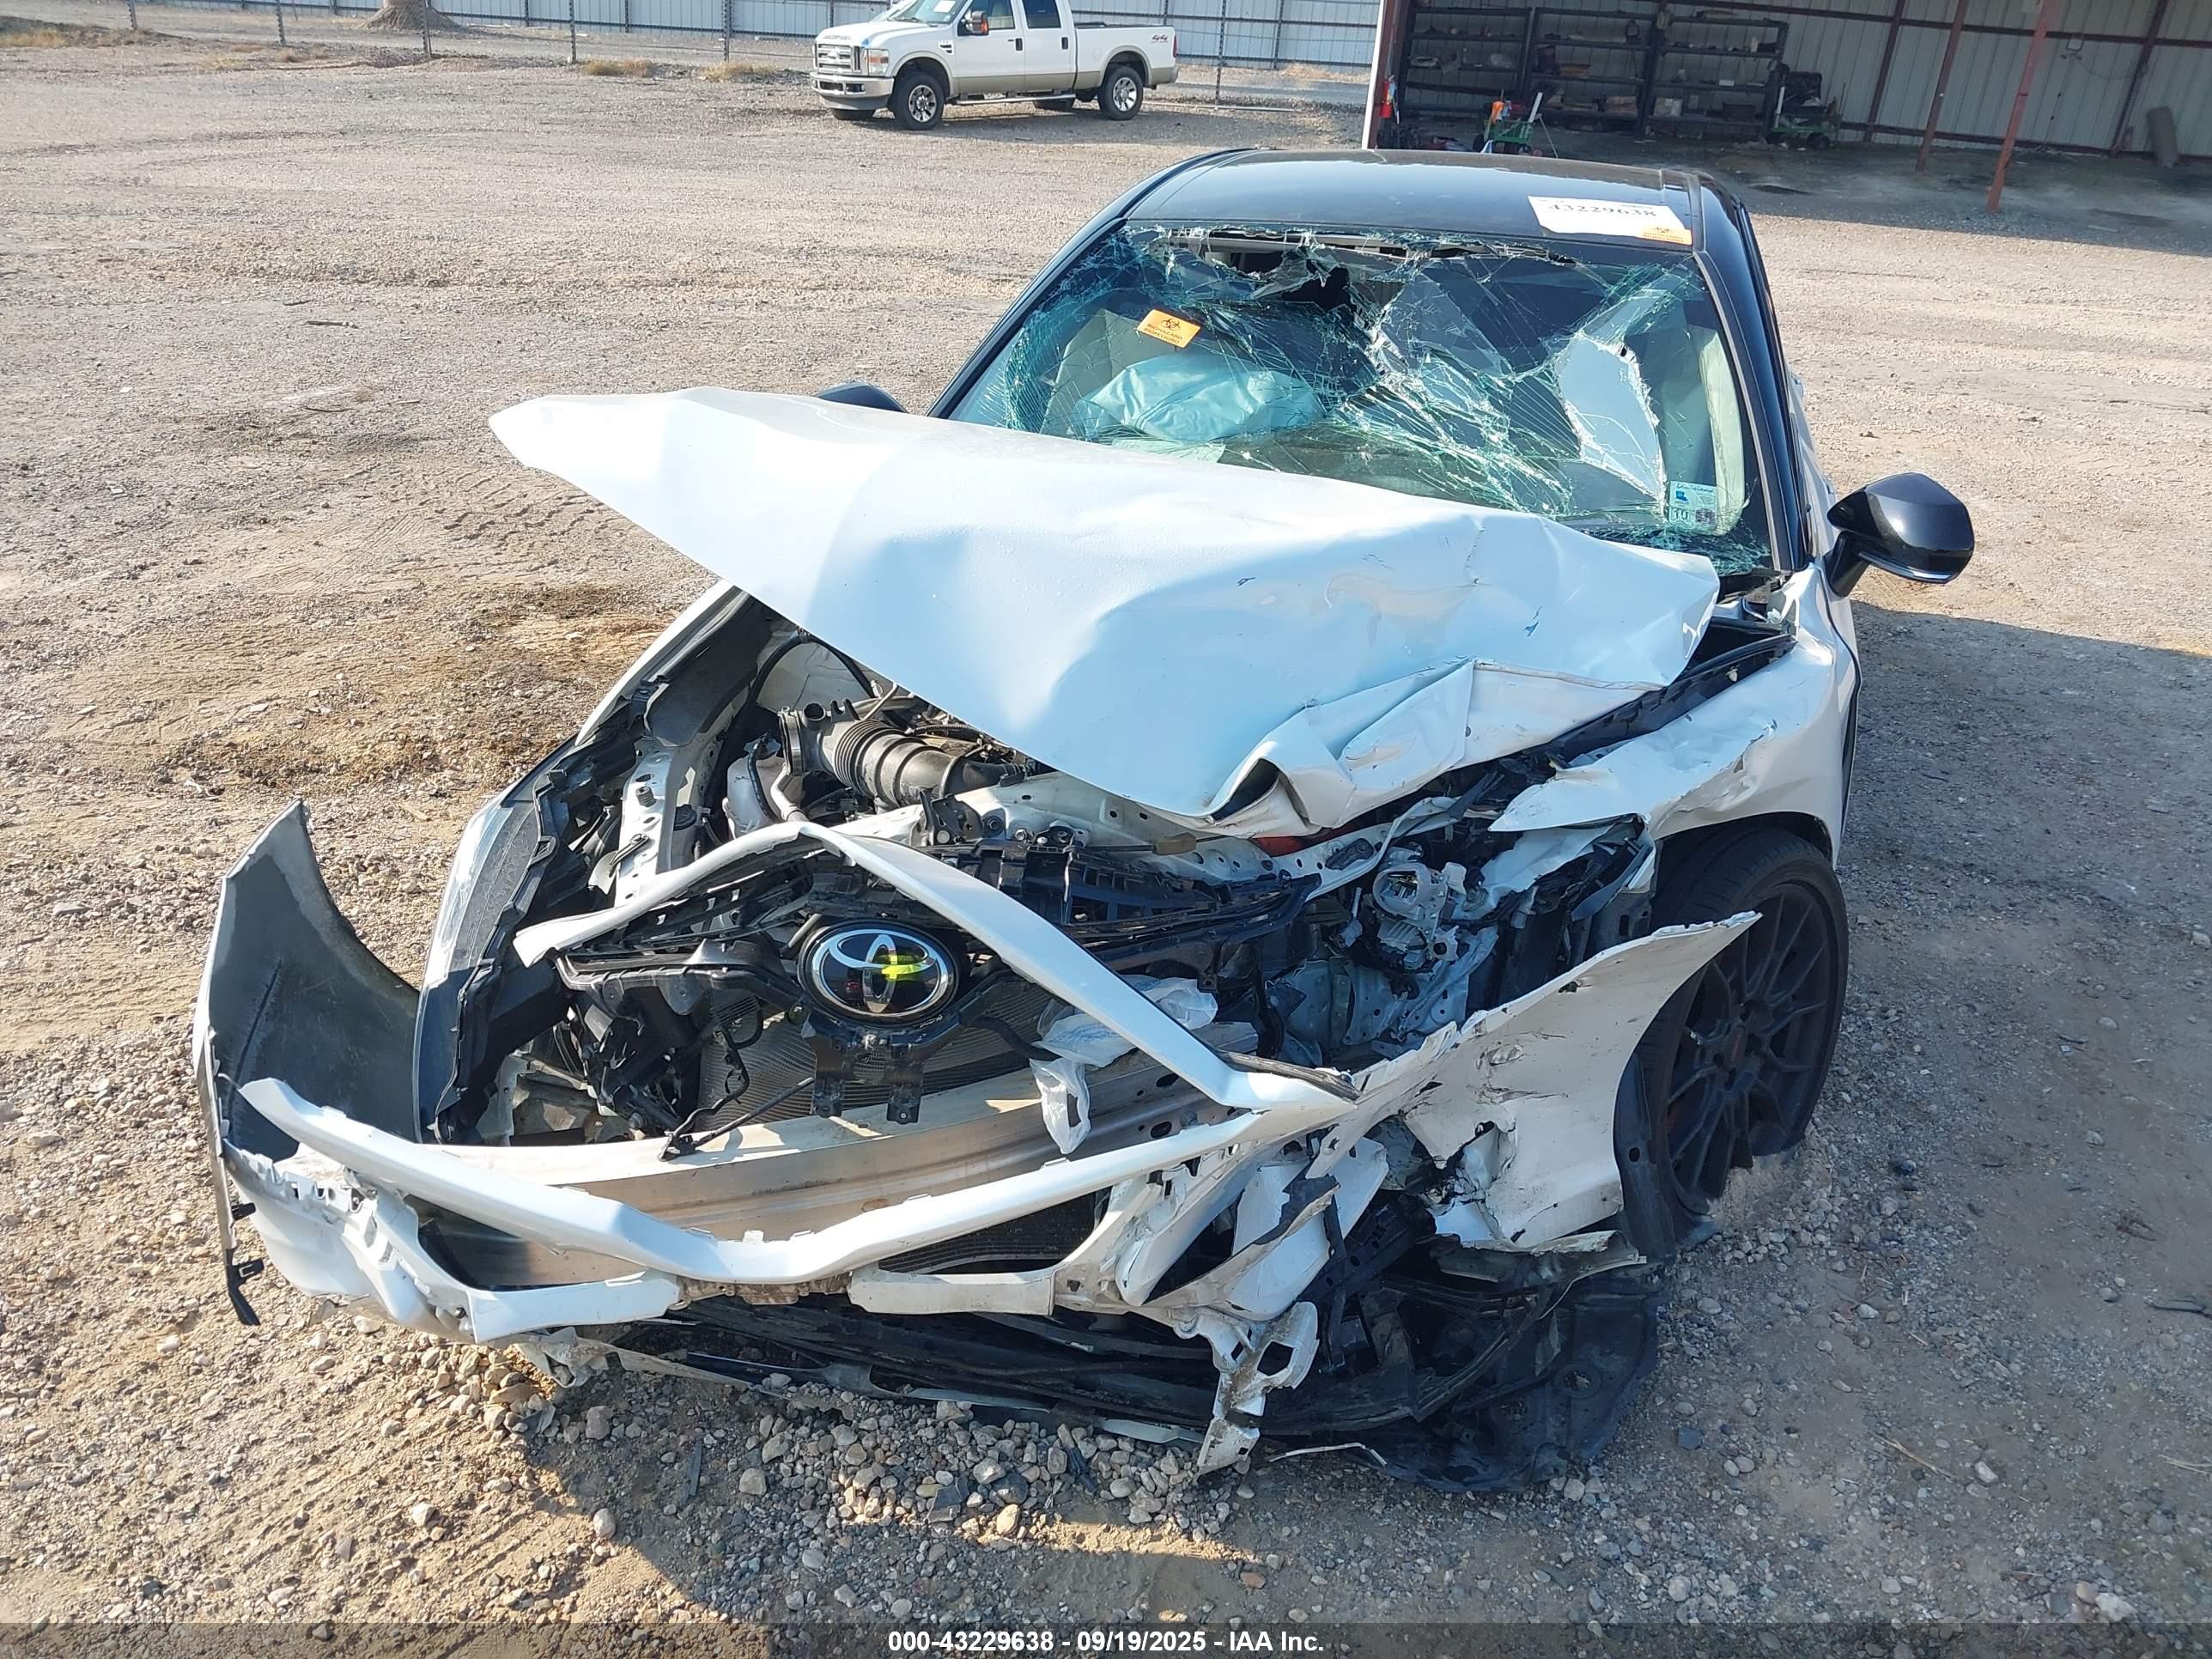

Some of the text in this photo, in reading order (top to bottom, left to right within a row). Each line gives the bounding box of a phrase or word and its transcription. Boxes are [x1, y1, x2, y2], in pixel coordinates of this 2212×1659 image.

[1548, 203, 1656, 216] 43229638
[1143, 327, 1180, 344] BIOPELIGRO
[1146, 323, 1183, 340] BIOHAZARD
